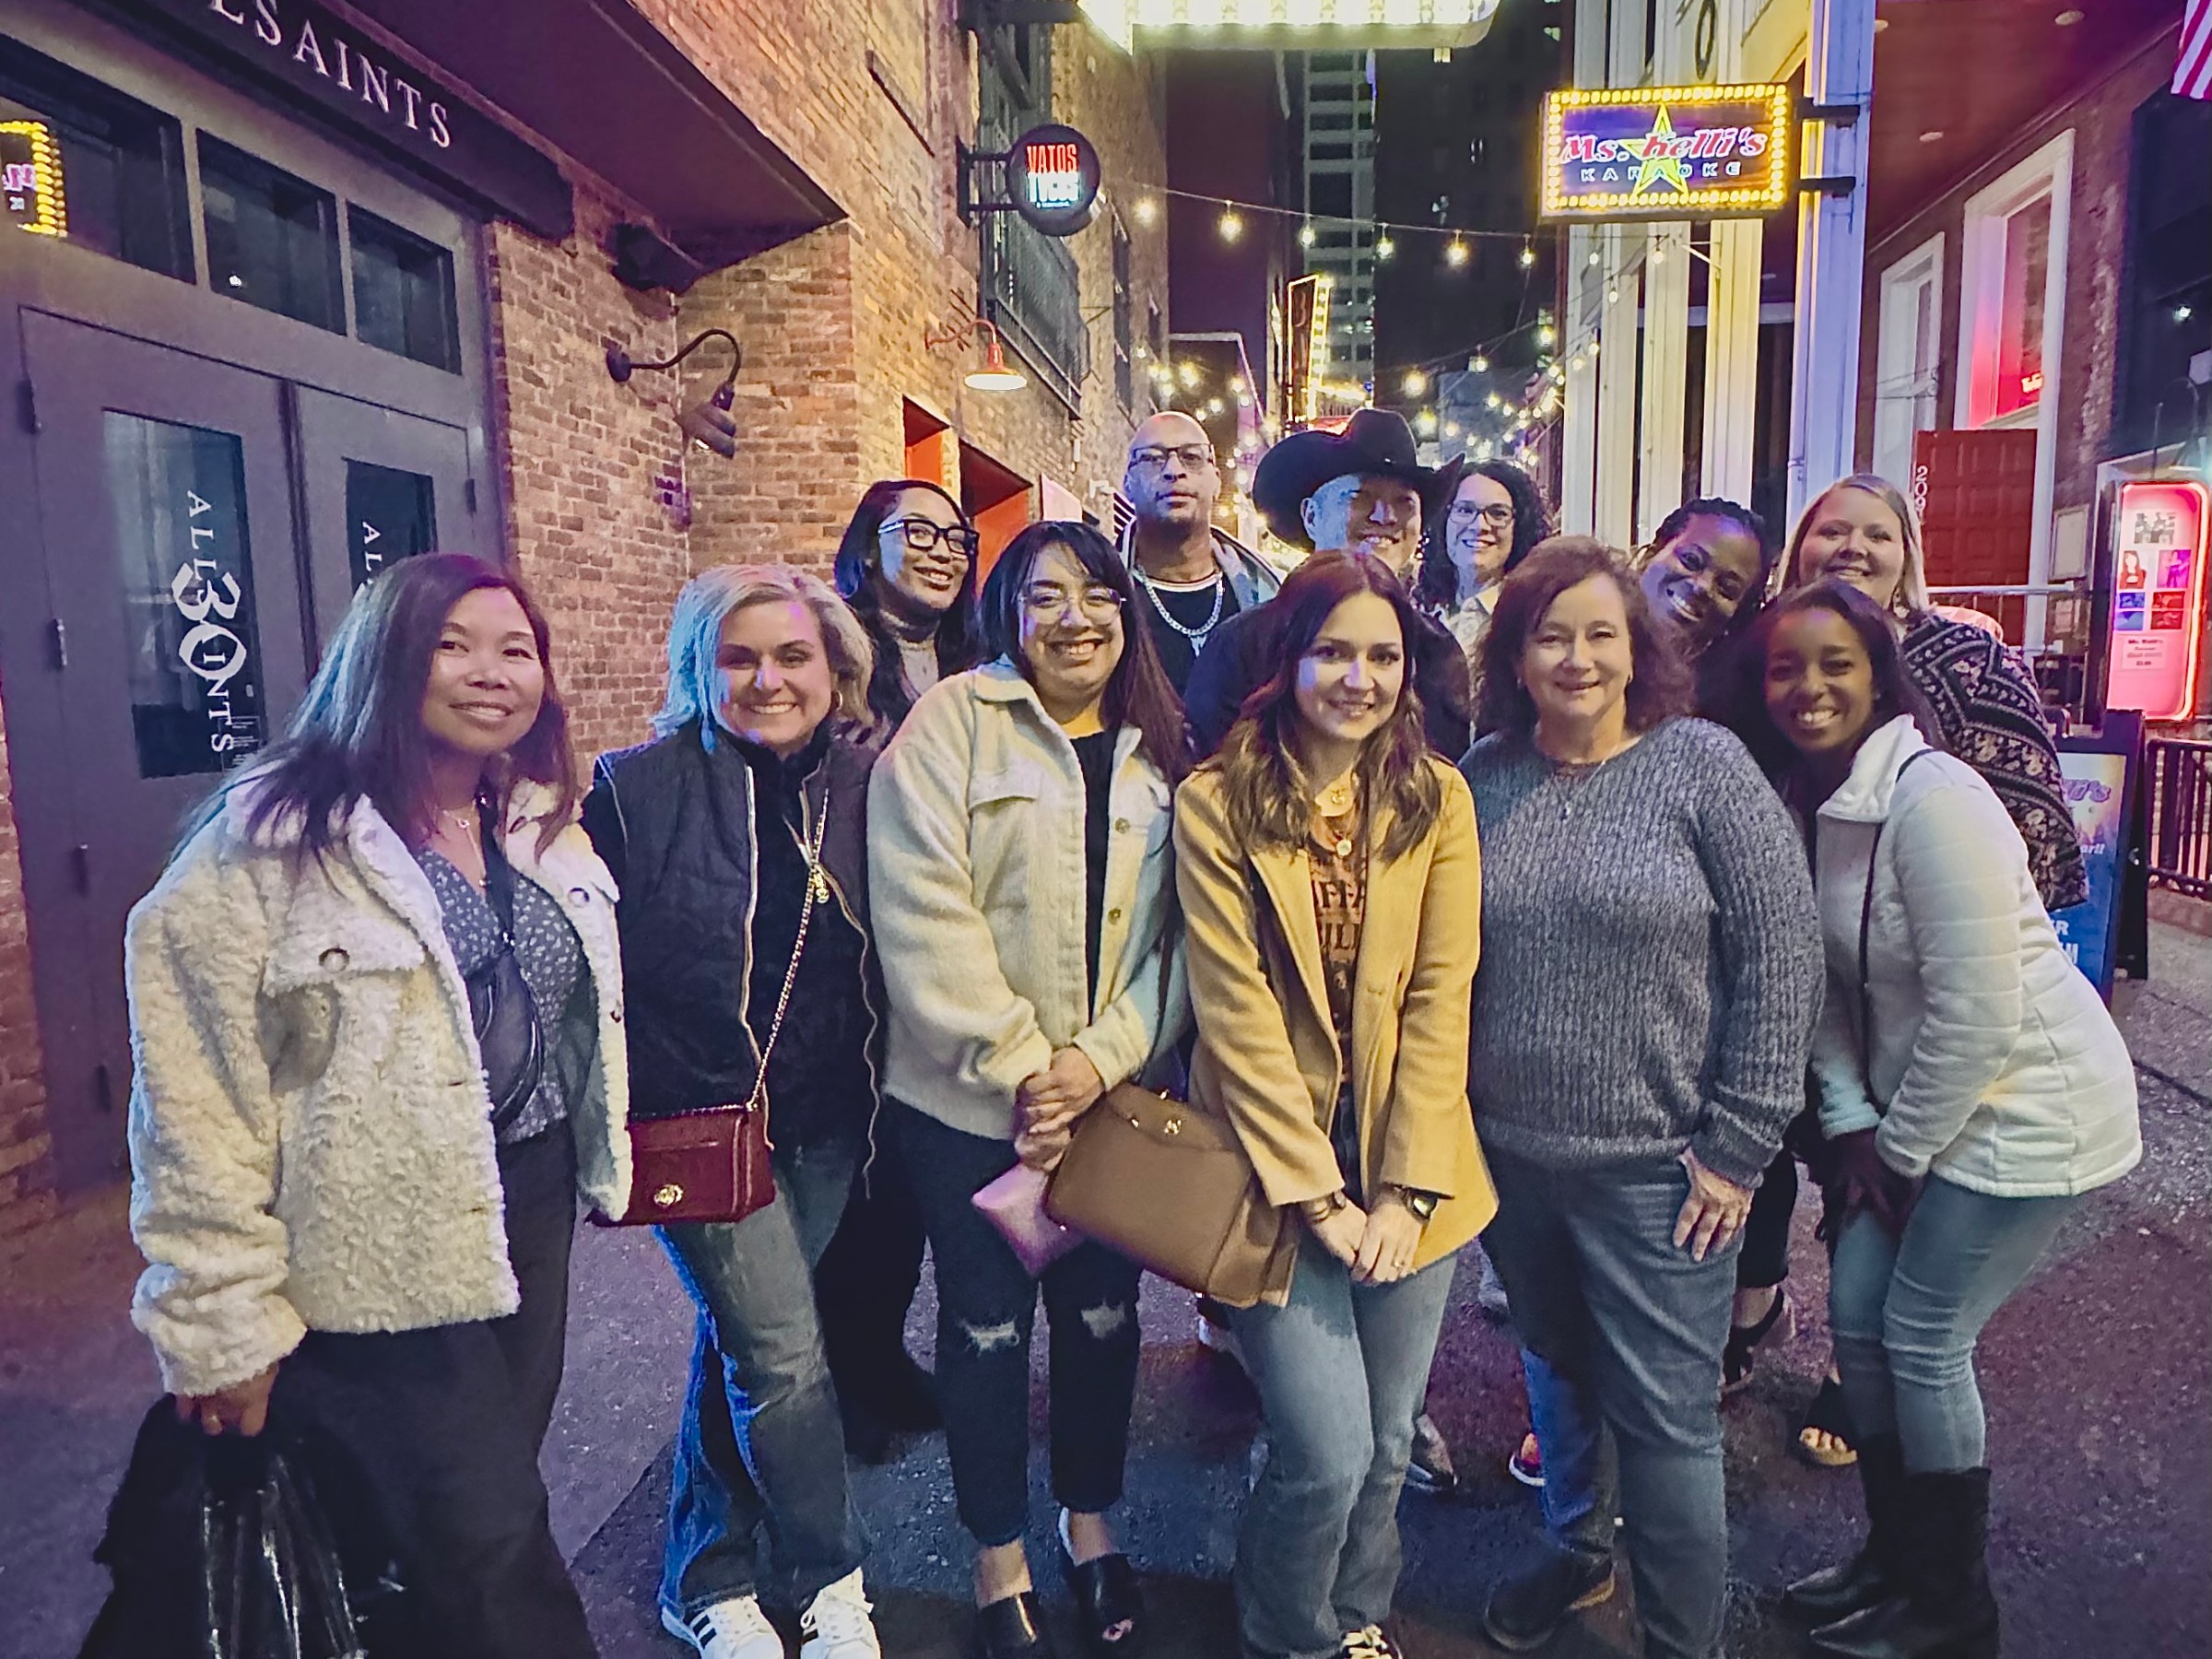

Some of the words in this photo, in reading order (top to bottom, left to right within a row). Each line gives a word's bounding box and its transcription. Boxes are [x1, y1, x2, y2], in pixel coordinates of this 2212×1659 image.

[1026, 144, 1077, 173] VATOS
[1560, 135, 1630, 164] Ms.
[1581, 161, 1741, 182] KARAOKE
